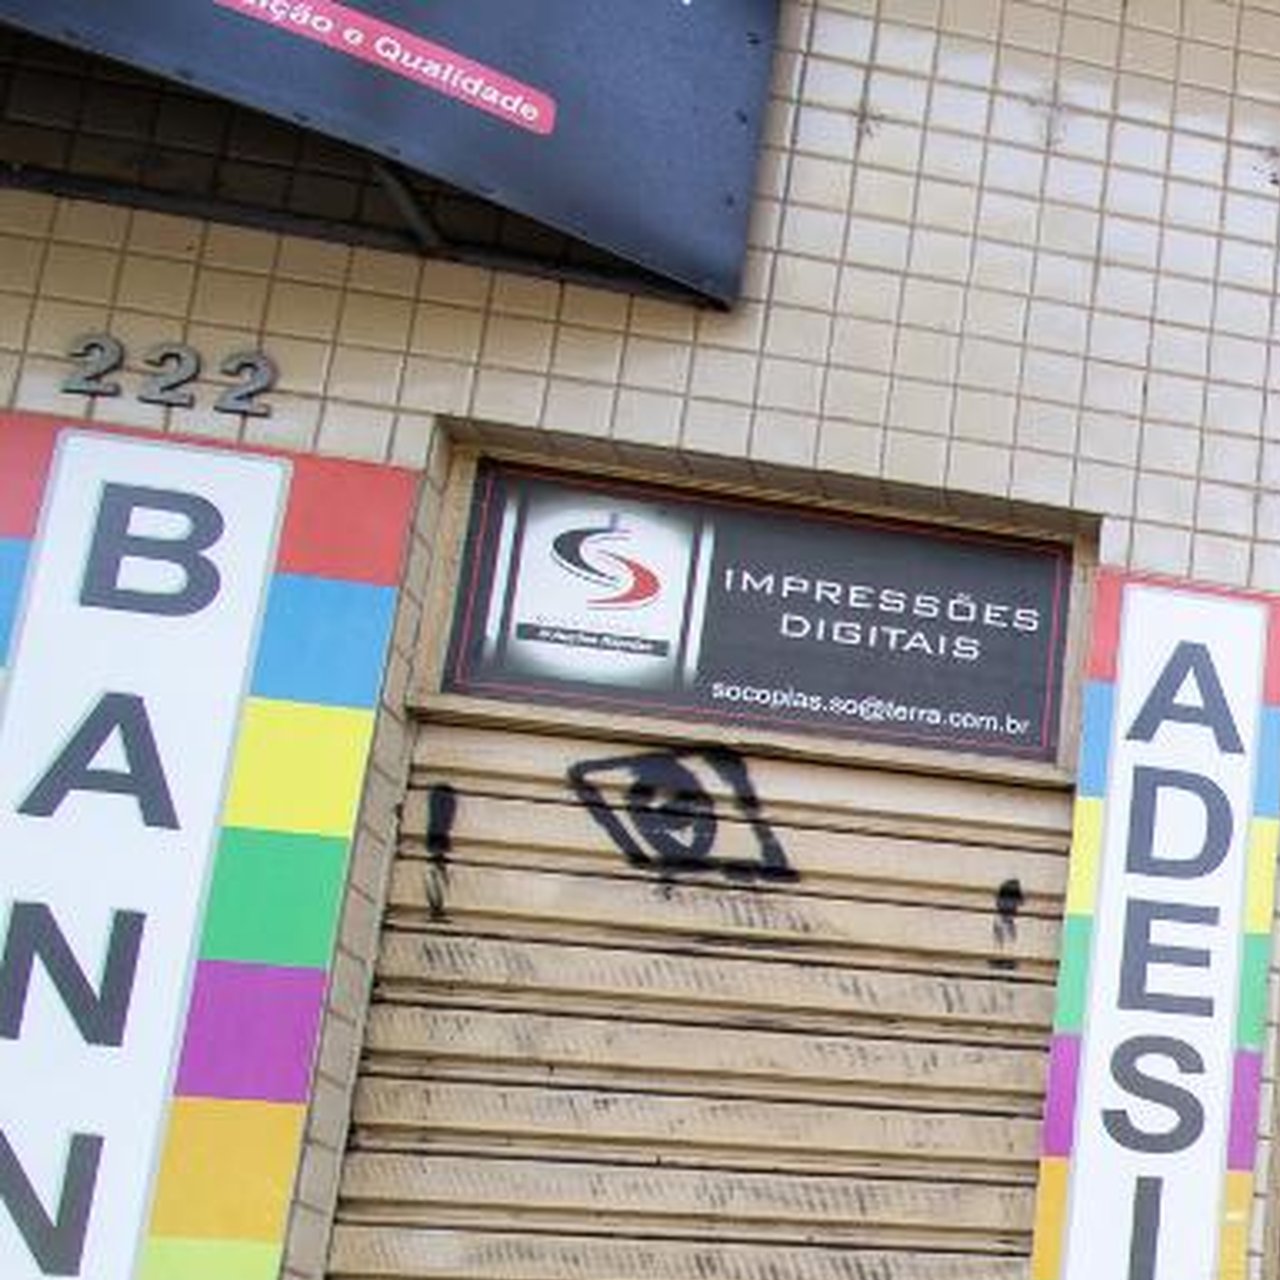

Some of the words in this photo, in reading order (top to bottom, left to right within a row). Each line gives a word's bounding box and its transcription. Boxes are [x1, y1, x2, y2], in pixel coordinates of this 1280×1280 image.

[342, 28, 365, 46] e
[373, 35, 540, 122] Qualidade
[58, 335, 280, 418] 222
[724, 568, 1040, 632] IMPRESSÕES
[780, 613, 982, 661] DIGITAIS
